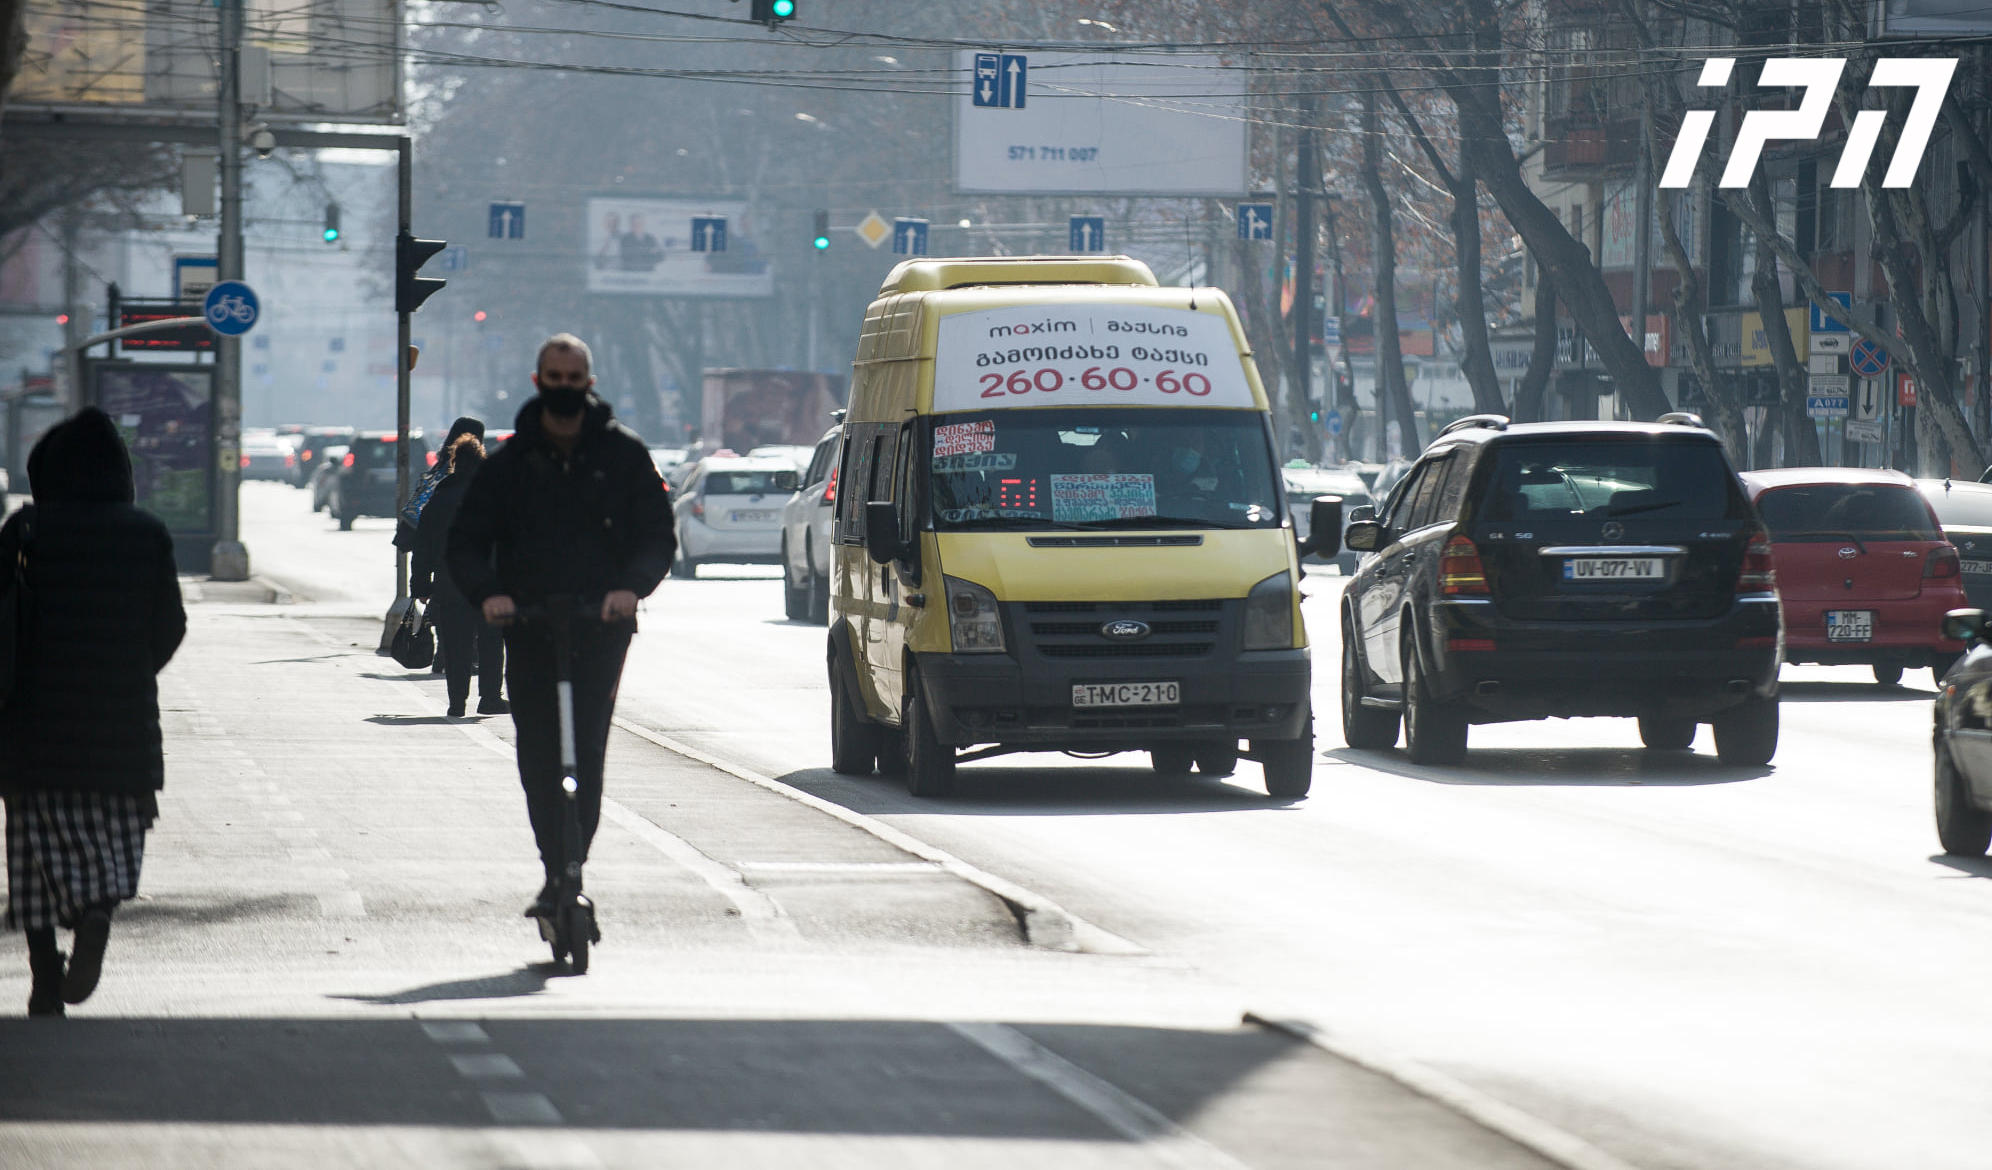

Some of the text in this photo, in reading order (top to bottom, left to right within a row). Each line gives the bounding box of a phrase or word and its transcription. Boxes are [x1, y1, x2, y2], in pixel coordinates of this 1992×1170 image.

[1008, 145, 1035, 160] 571
[1040, 146, 1065, 161] 711
[989, 318, 1076, 338] maxim
[1107, 320, 1188, 337] მაქსიმ
[976, 345, 1208, 367] გამოიძახე ტაქსი
[1576, 560, 1653, 577] UV-077-VV
[1112, 623, 1139, 635] Ford
[1829, 624, 1872, 637] 720-FF
[1086, 684, 1177, 704] TMC-210
